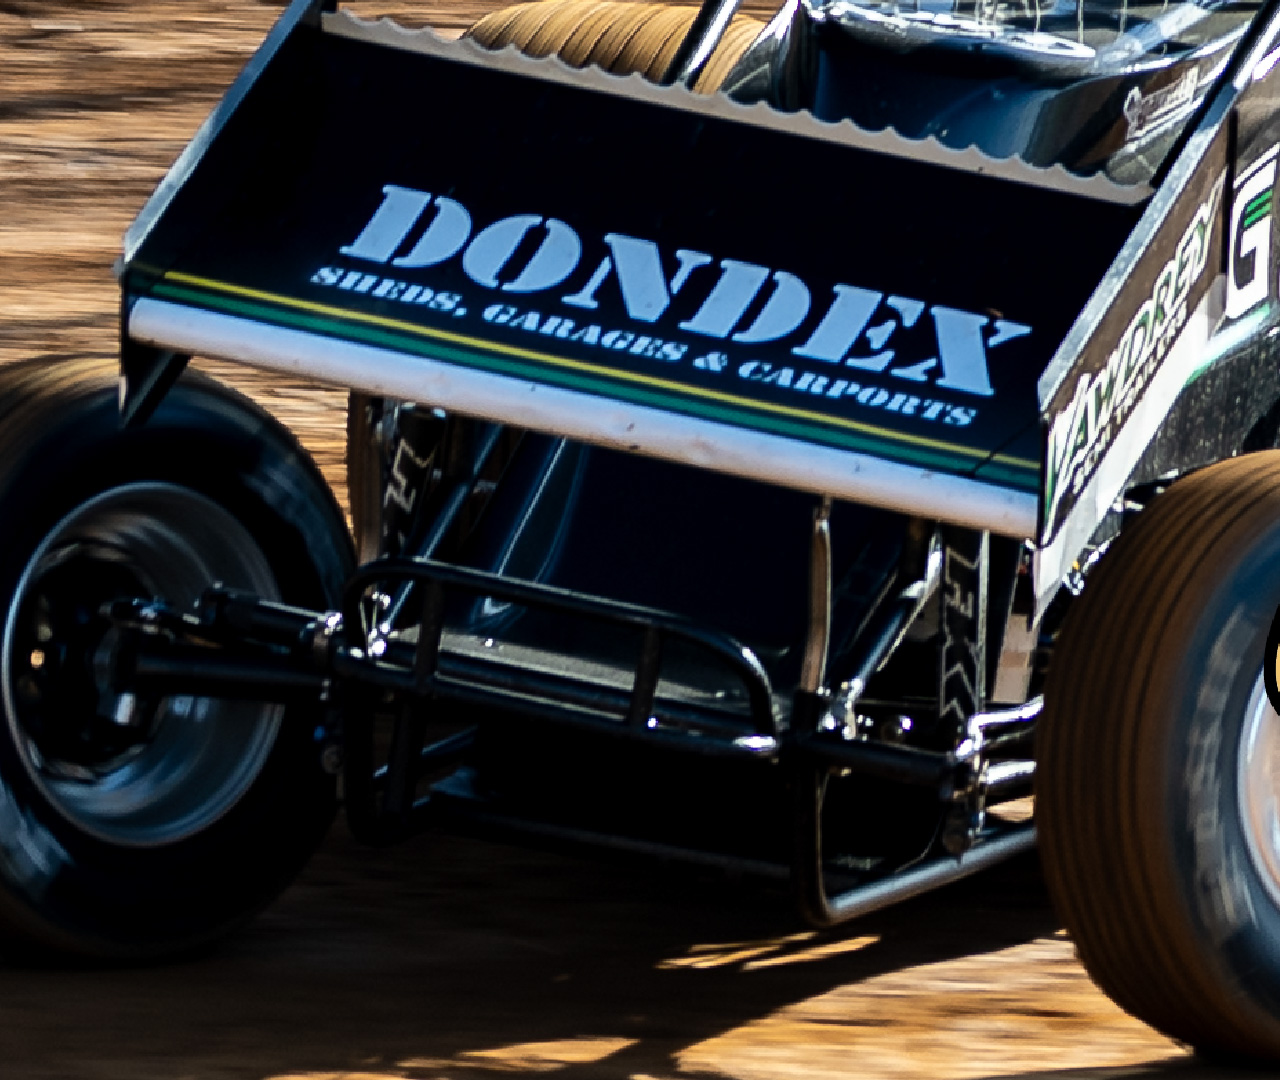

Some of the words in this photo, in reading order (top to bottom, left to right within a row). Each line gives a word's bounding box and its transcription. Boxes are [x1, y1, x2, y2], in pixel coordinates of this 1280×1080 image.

[309, 264, 470, 317] SHEDS,
[482, 303, 688, 365] GARAGES
[694, 349, 730, 375] &
[736, 358, 980, 429] CARPORTS
[339, 184, 1034, 397] DONDEX
